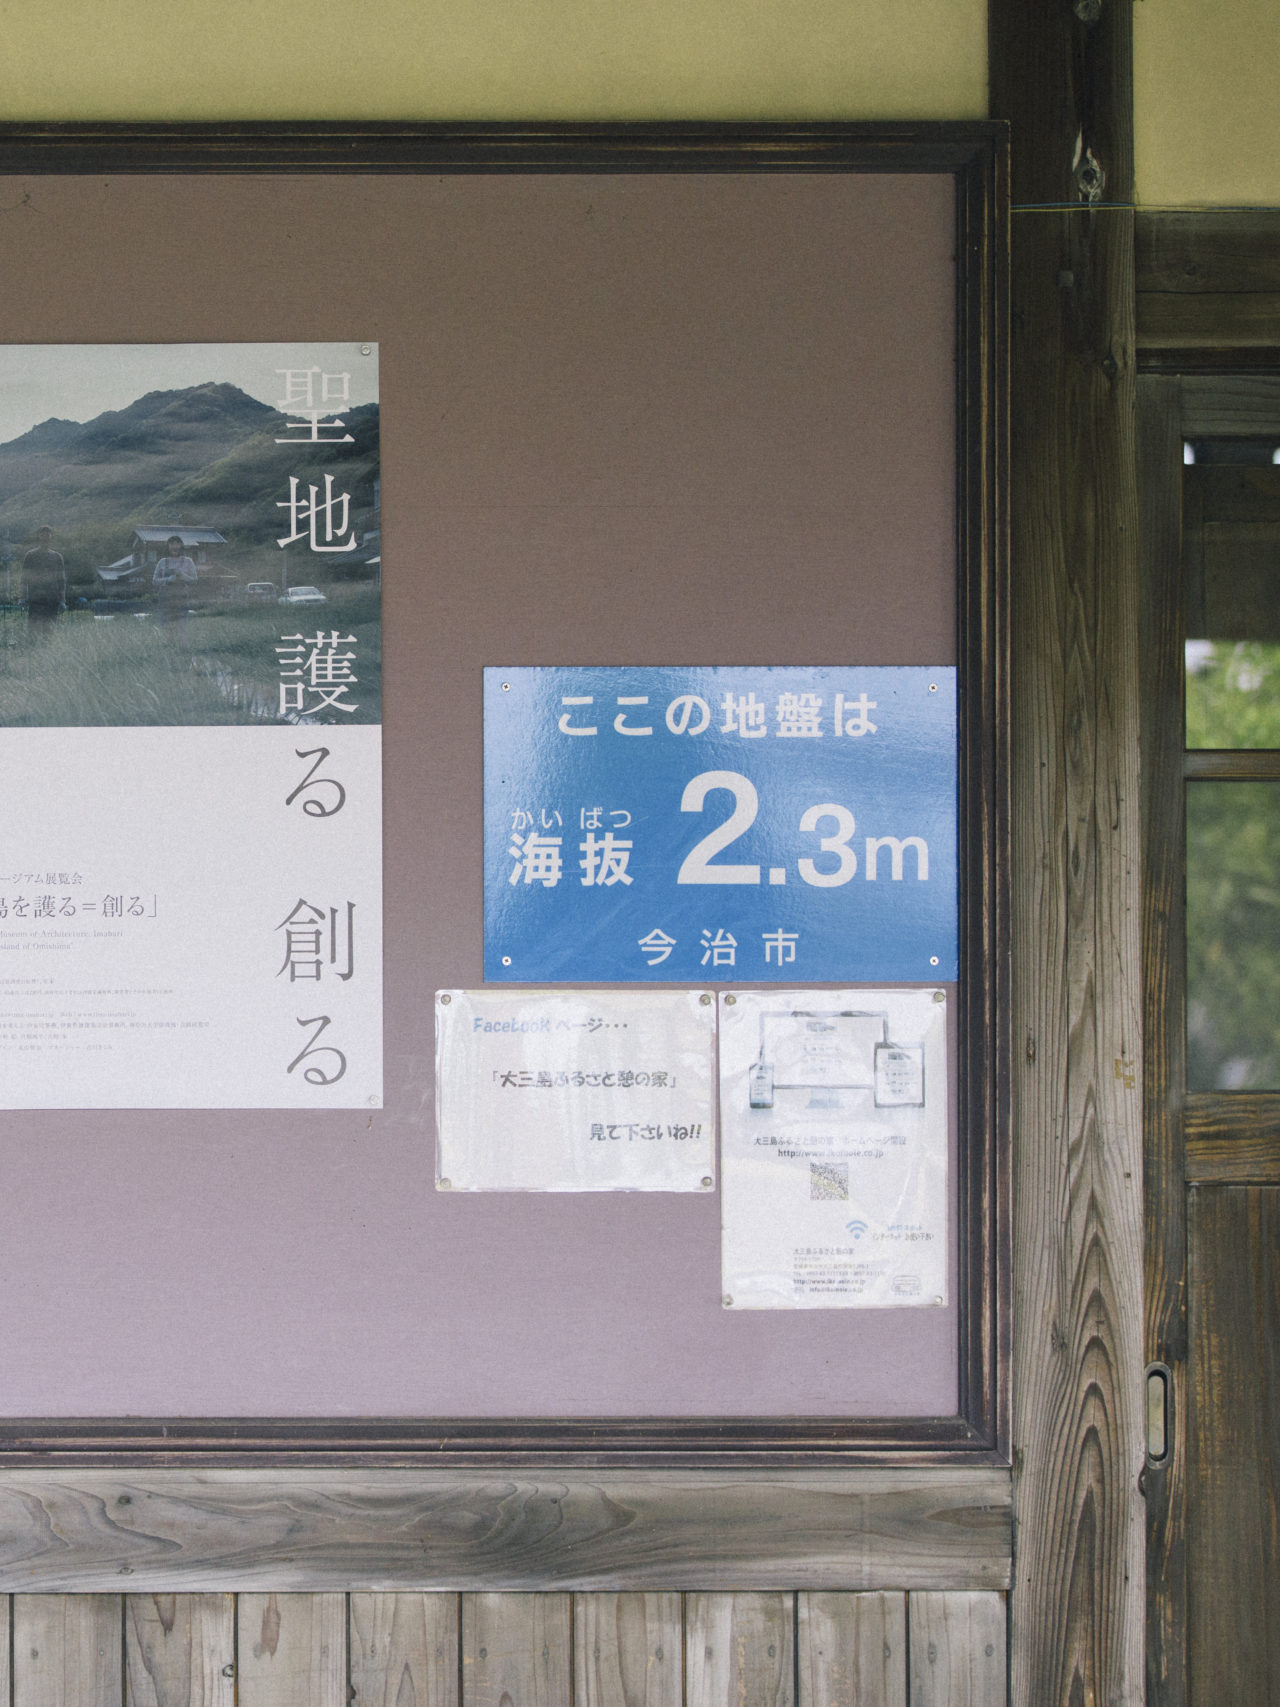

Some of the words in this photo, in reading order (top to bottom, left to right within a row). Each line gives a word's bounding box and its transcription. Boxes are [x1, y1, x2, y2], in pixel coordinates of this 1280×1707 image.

[270, 363, 360, 552] 聖地
[558, 691, 878, 738] ここの地盤は
[507, 832, 634, 887] 海抜
[676, 770, 929, 888] 2.3m
[637, 927, 800, 967] 今治市
[274, 897, 357, 1086] 創る
[473, 1015, 551, 1034] Facebook
[491, 1068, 677, 1090] 「大三島ふるさと憩の家」
